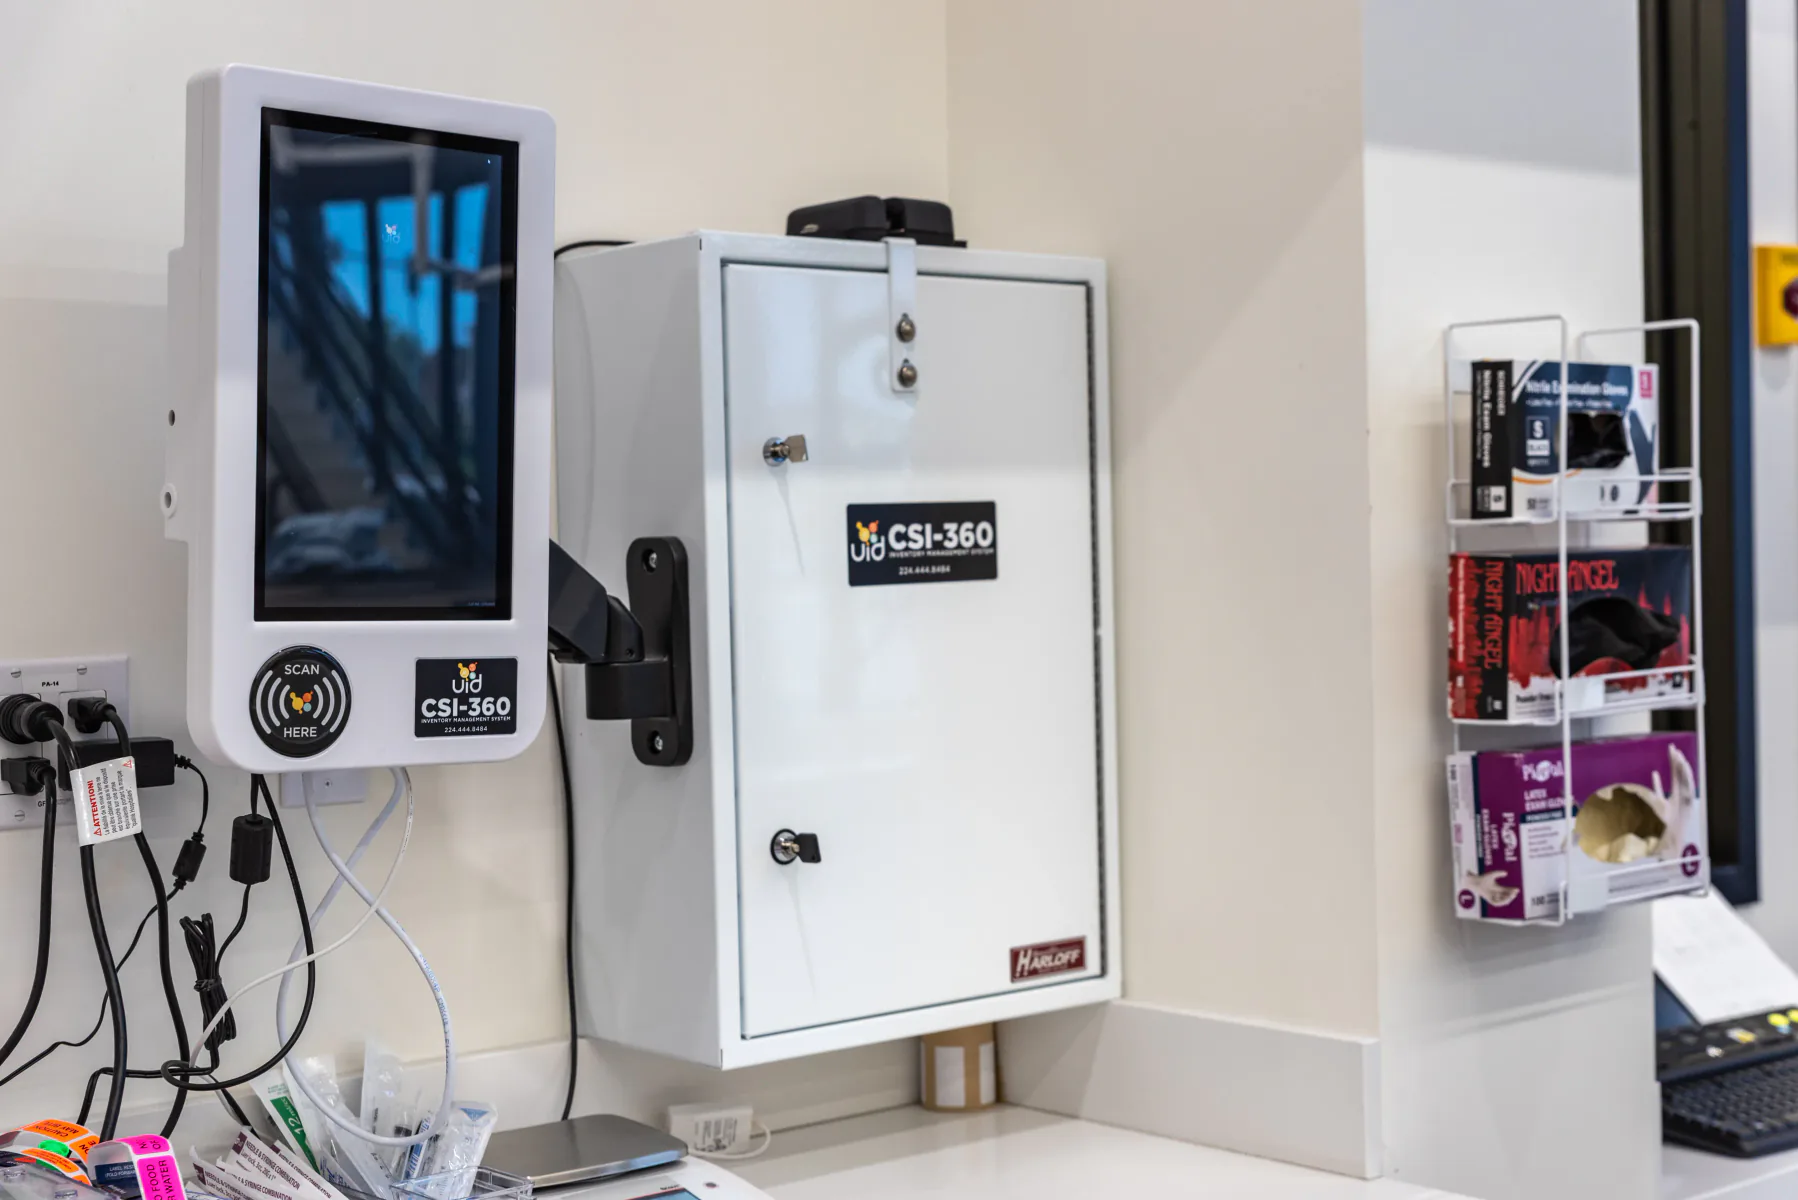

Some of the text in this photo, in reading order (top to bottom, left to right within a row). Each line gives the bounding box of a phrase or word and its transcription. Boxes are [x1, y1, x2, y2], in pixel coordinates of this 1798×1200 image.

[1533, 420, 1544, 438] S
[888, 521, 994, 550] CSI-360
[284, 664, 320, 675] SCAN
[421, 696, 511, 718] CSI-360
[283, 727, 318, 737] HERE
[87, 780, 100, 827] ATTENTION!
[246, 1140, 260, 1156] NEEDLE
[261, 1152, 277, 1172] SYRINGE
[275, 1165, 301, 1191] COMBINATION
[146, 1164, 161, 1192] FOOD
[244, 1179, 263, 1193] SYRINGE
